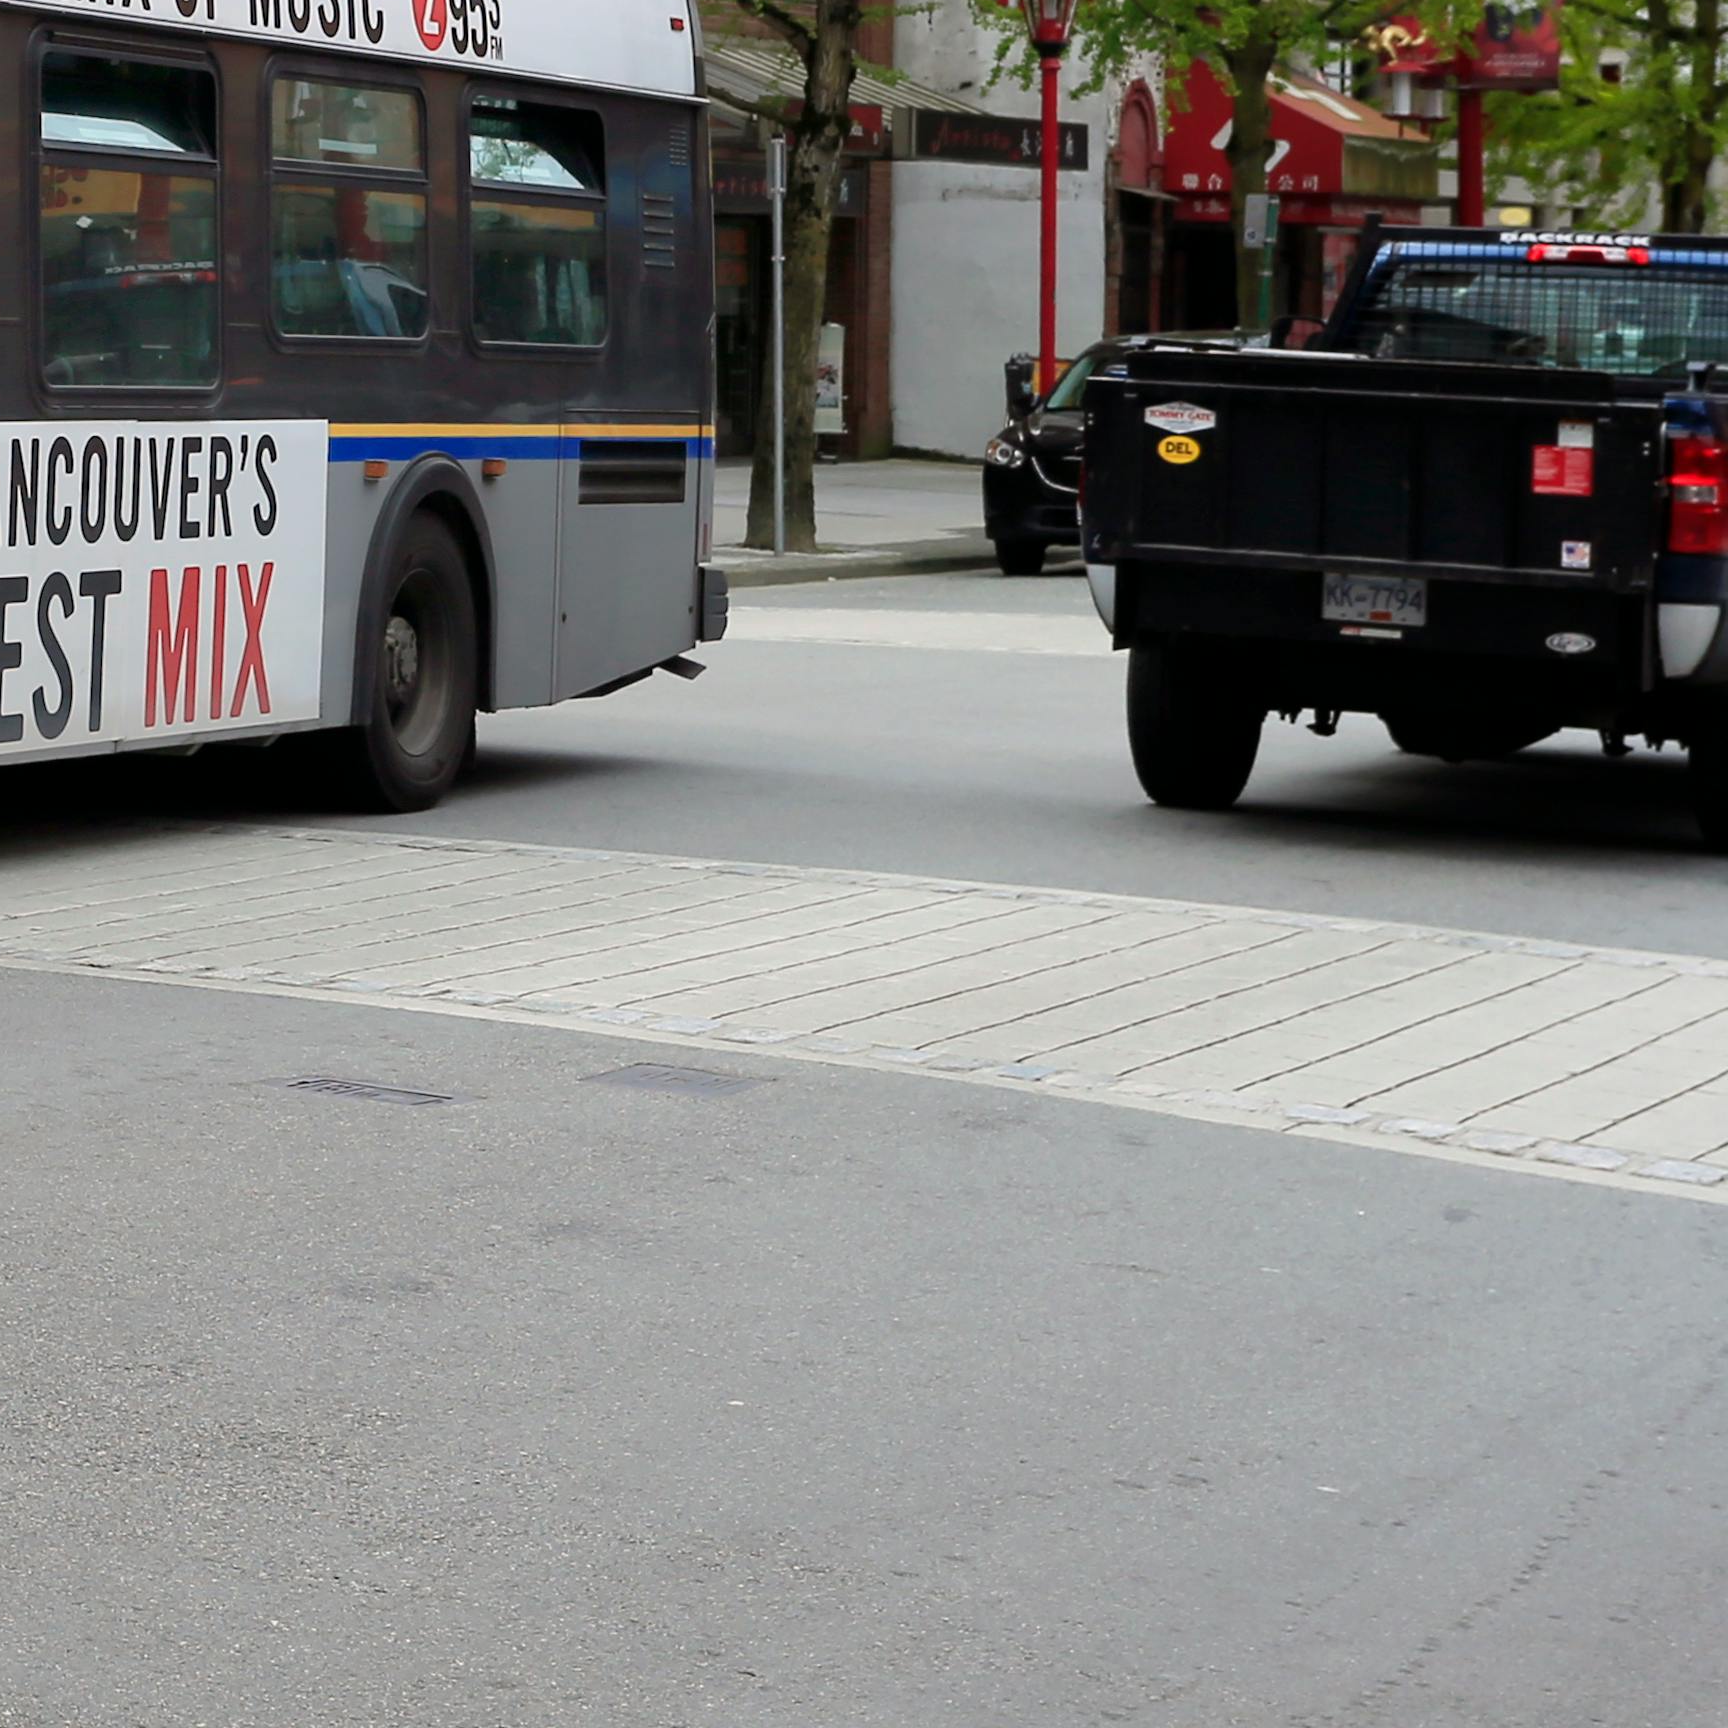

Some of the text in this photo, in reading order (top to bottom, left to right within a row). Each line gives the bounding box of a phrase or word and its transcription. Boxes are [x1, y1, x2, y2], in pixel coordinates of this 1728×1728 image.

[1500, 231, 1650, 247] BACKRACK
[1165, 441, 1193, 456] DEL
[144, 562, 275, 728] MIX
